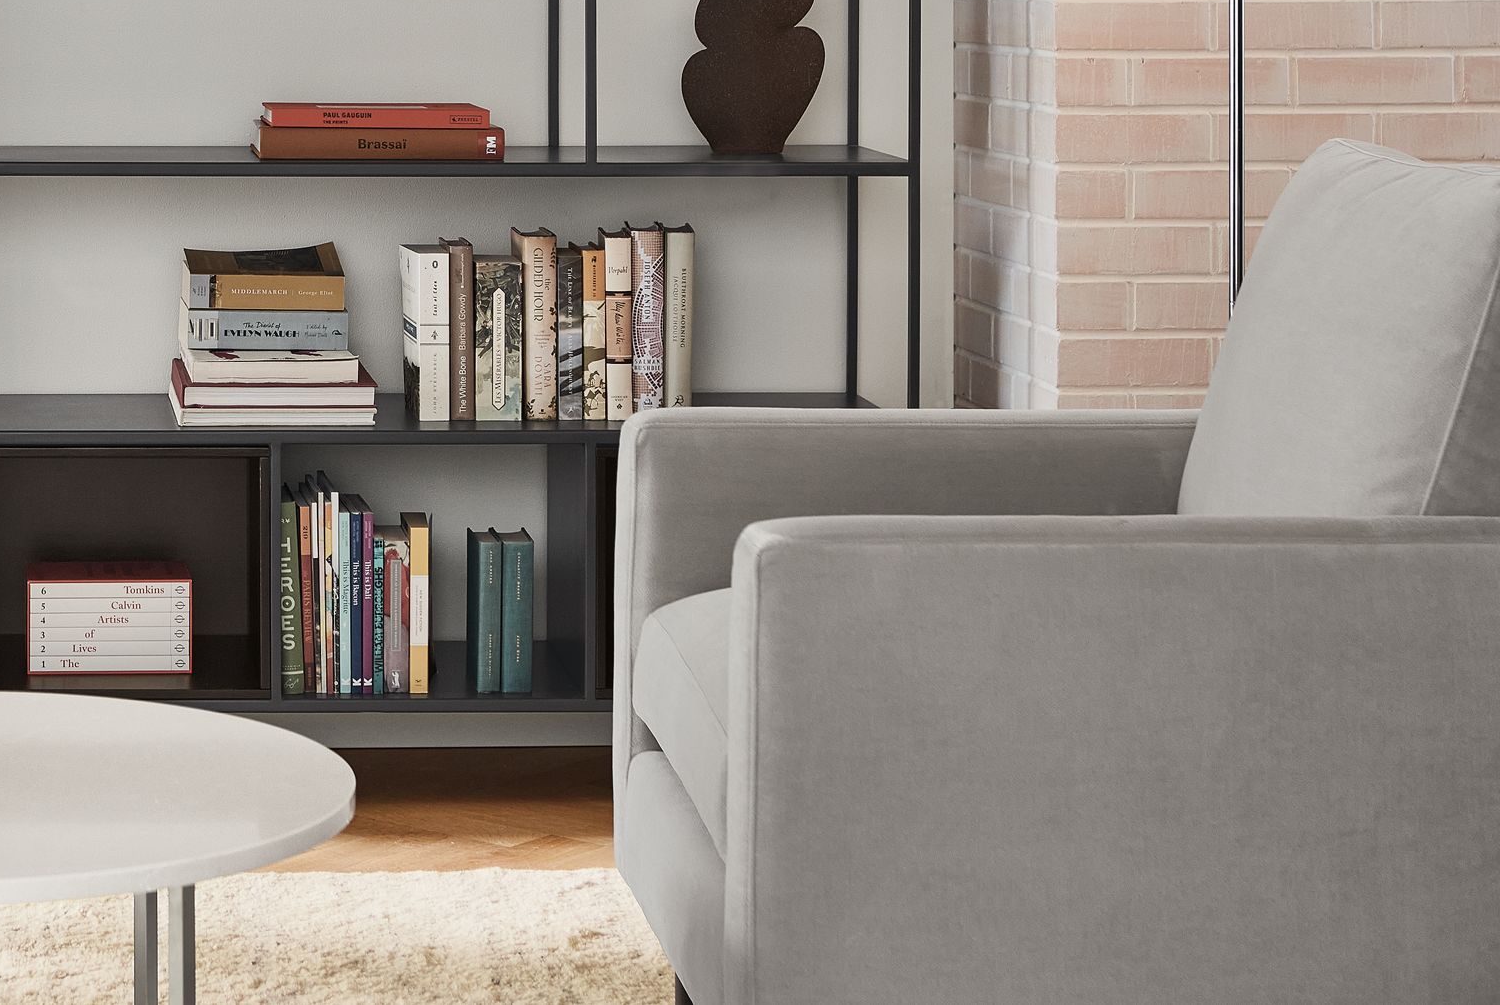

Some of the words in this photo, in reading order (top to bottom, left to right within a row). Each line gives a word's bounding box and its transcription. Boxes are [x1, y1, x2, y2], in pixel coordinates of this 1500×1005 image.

[358, 138, 407, 149] Brassaï
[533, 248, 543, 288] GILDED
[459, 293, 467, 320] Gowdy
[533, 291, 543, 322] HOUR
[609, 302, 626, 312] My
[41, 587, 46, 595] 6
[124, 585, 164, 594] Tomkins
[304, 580, 312, 607] PARIS
[374, 567, 383, 630] BURROUGHS
[111, 601, 141, 609] Calvin
[40, 631, 46, 639] 3
[84, 629, 95, 638] of
[41, 645, 46, 653] 2
[374, 632, 383, 673] WILLIAM
[60, 659, 80, 667] The
